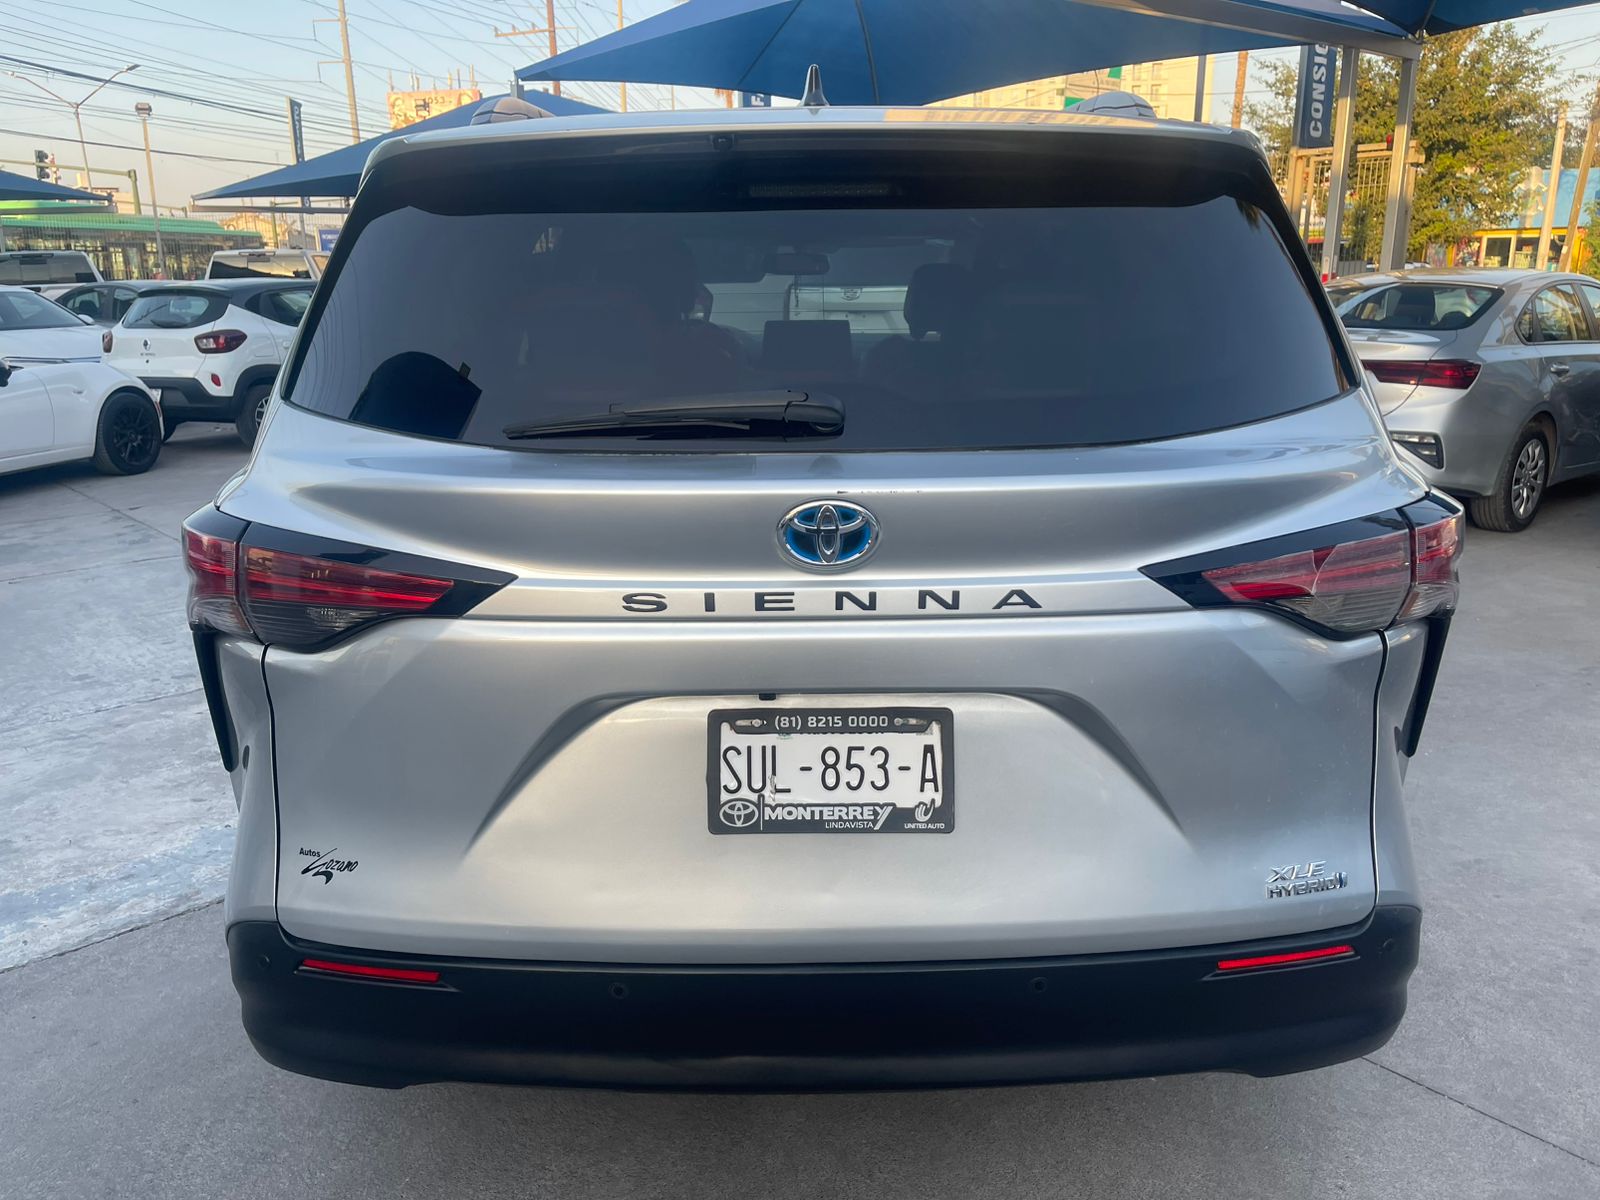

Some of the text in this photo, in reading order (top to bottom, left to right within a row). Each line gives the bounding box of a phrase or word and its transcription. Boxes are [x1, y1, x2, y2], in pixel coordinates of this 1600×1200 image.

[621, 589, 1043, 612] SIENNA
[774, 715, 888, 730] (81) 8215 0000
[764, 805, 893, 828] MONTERREY
[825, 821, 874, 829] LINDAVISTA
[299, 847, 321, 858] Autos
[1265, 860, 1327, 883] XLE
[1265, 872, 1347, 899] HYBRID
